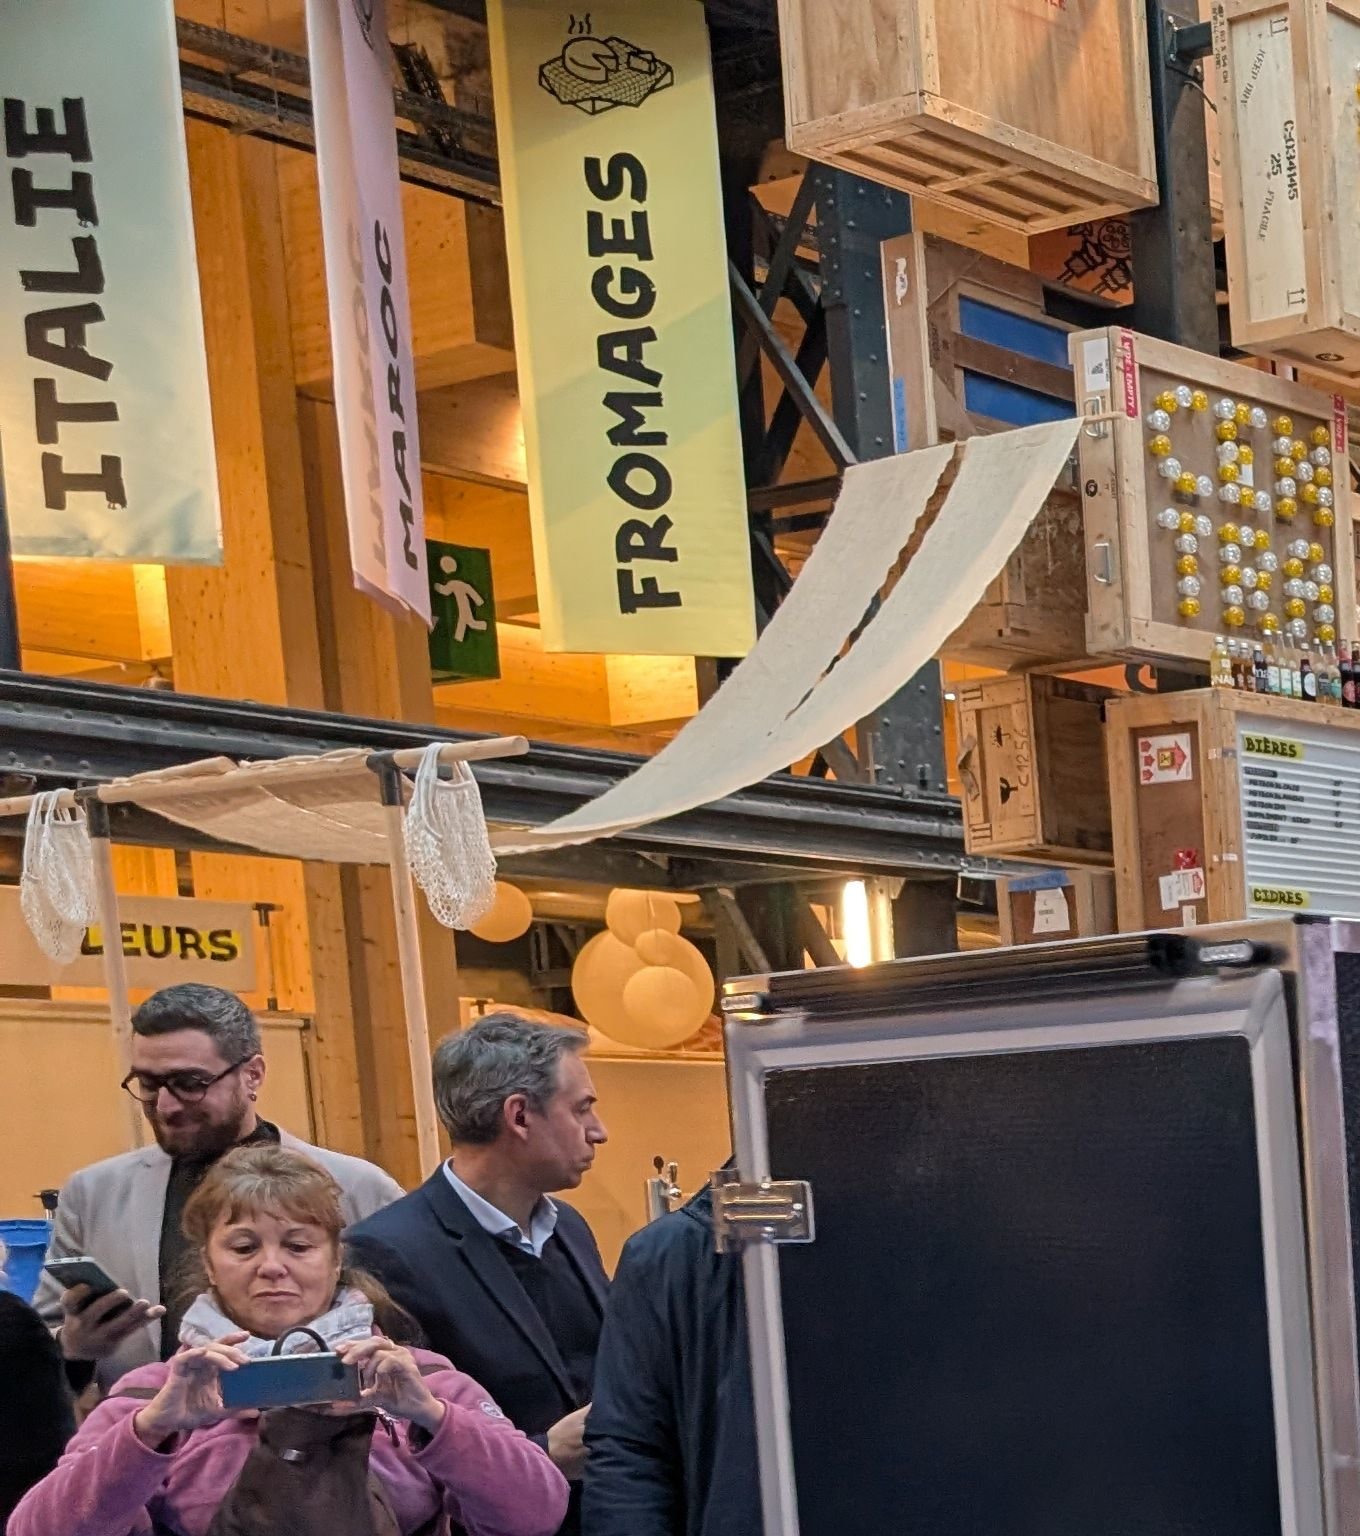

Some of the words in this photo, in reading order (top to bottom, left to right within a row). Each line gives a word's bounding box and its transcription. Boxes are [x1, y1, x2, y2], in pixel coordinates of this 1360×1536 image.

[3, 96, 129, 513] ITALIE
[372, 217, 419, 572] MAROC
[584, 149, 683, 616] FROMAGES
[1245, 736, 1298, 758] BIÈRES
[80, 922, 239, 962] LEURS
[1253, 888, 1304, 906] CIDRES
